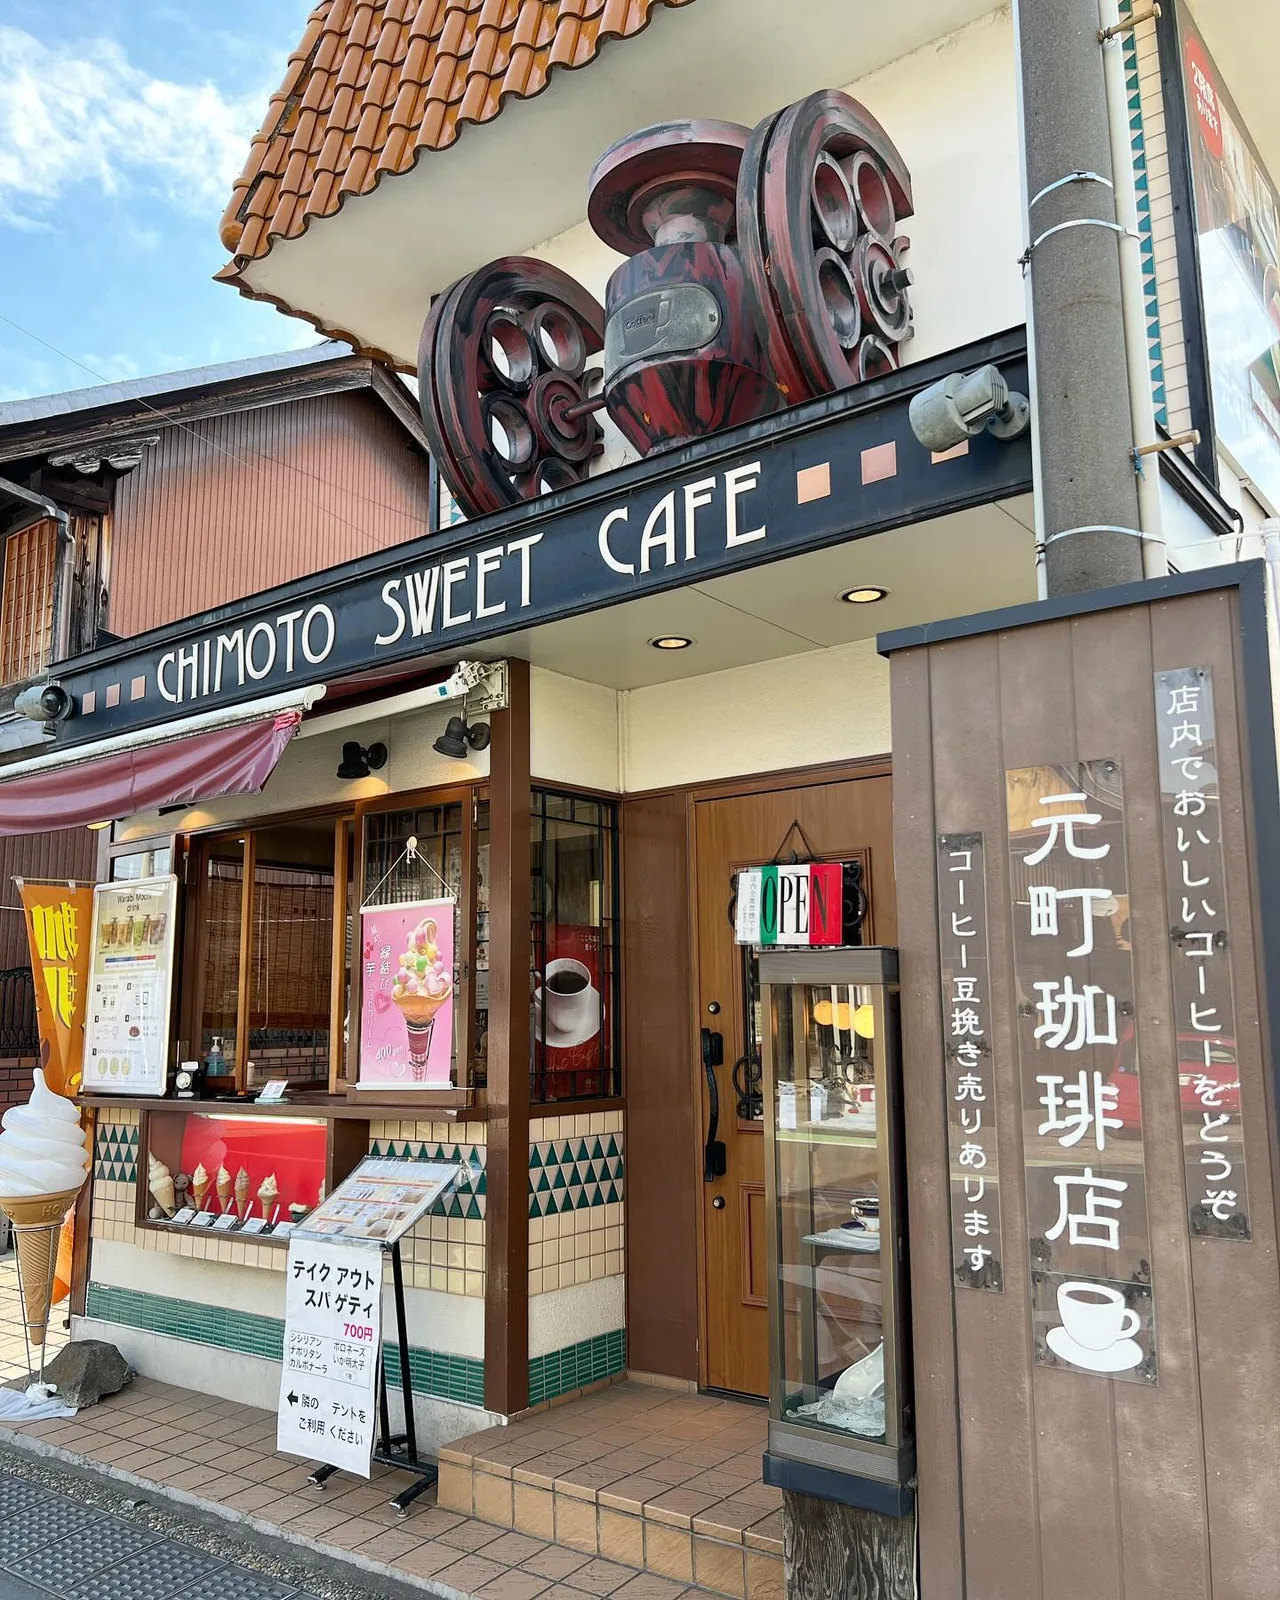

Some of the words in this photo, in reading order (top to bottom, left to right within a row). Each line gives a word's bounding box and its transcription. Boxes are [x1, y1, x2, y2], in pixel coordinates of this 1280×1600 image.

[624, 313, 656, 330] Coffee
[156, 603, 335, 704] CHIMOTO
[374, 532, 545, 646] SWEET
[598, 460, 766, 576] CAFE
[762, 874, 829, 934] OPEN
[1167, 685, 1237, 1220] 店内でおいしいコーヒーをどうぞ
[1023, 792, 1128, 1251] 元町珈琲店
[376, 1043, 392, 1061] 400
[948, 851, 992, 1272] コーヒー豆挽き売りあります
[290, 1332, 323, 1347] シシリアン
[343, 1323, 373, 1342] 700円
